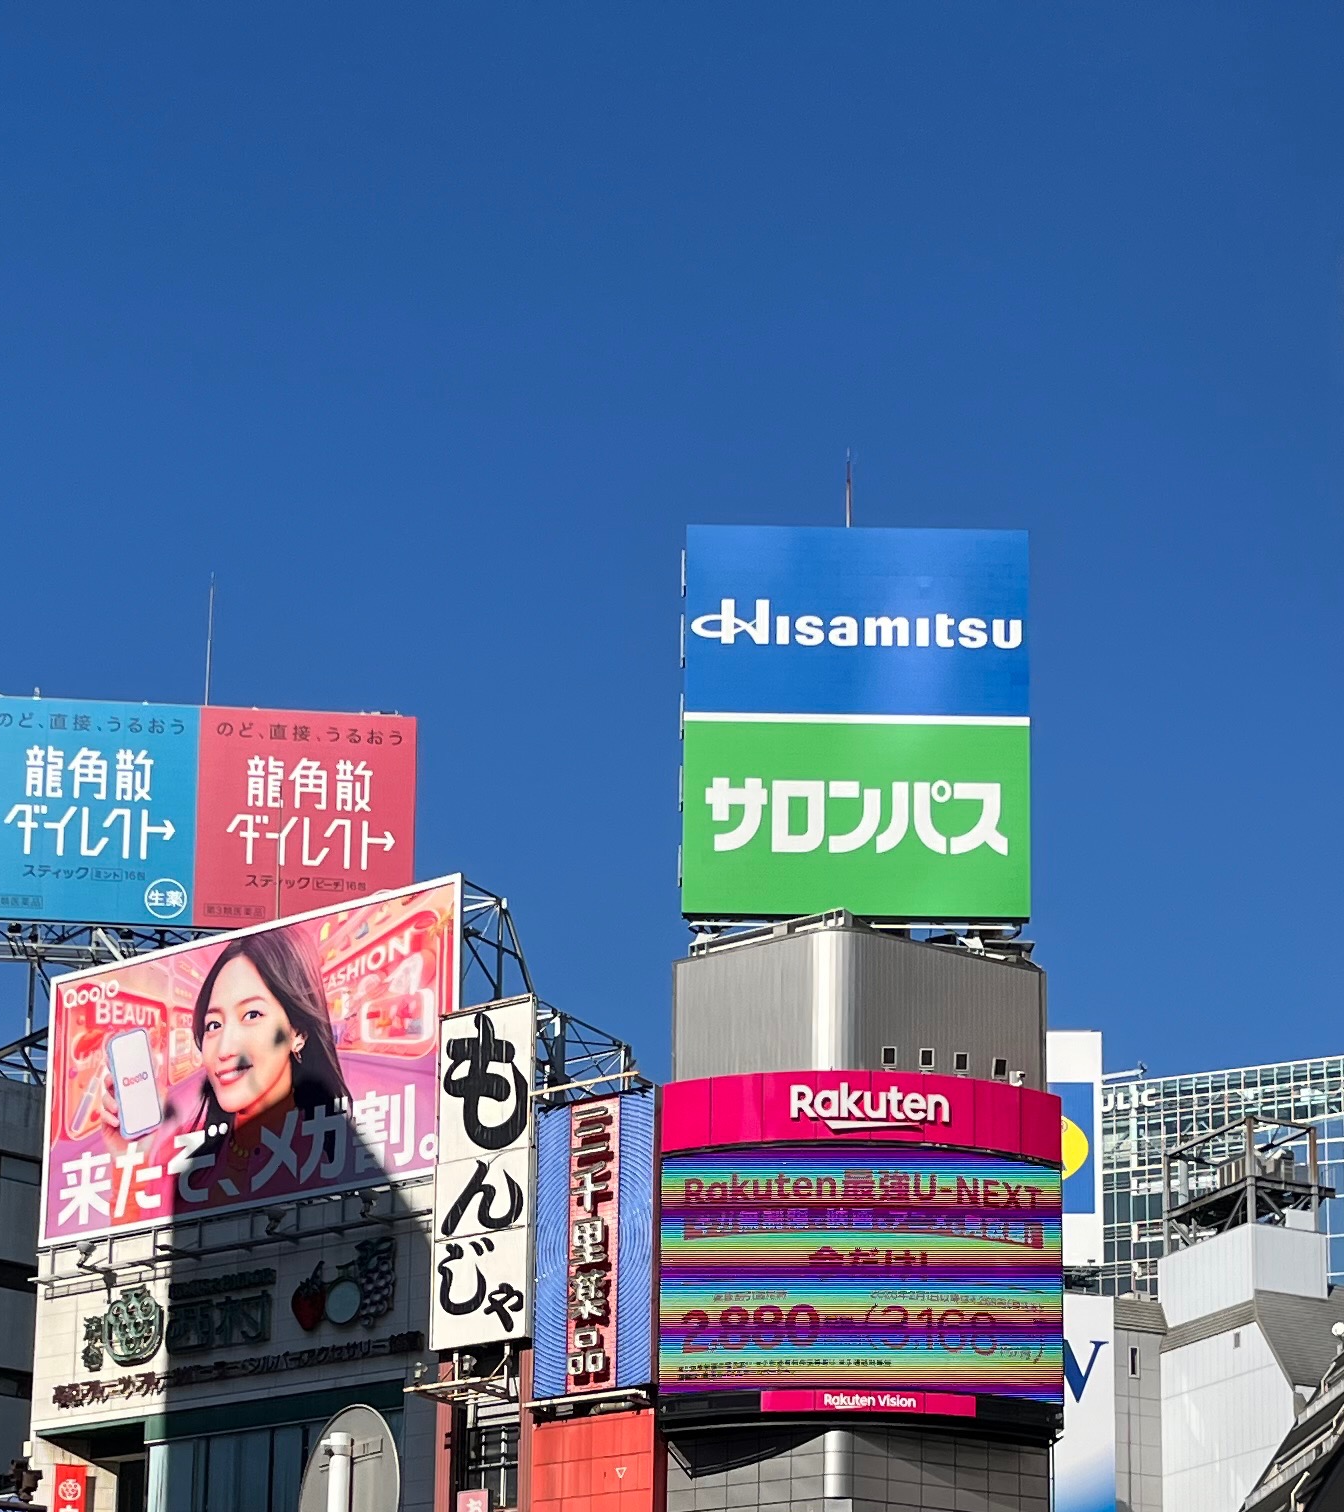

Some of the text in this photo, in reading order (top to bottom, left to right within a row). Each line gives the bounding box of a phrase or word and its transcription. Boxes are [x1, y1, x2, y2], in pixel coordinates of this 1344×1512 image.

[690, 598, 1023, 649] Hisamitsu
[216, 720, 403, 747] のど、直接、うるおう
[25, 744, 154, 802] 龍角散
[247, 754, 374, 813] 龍角散
[3, 803, 175, 861] ダイレクト
[226, 814, 396, 871] ダイレクト
[705, 777, 1009, 856] サロンパス
[22, 864, 89, 880] スティック
[147, 889, 184, 907] 生薬
[63, 979, 119, 1010] Qoo10
[788, 1082, 951, 1124] Rakuten
[438, 1011, 528, 1332] もんじゃ
[568, 1103, 611, 1377] 三千里薬品
[823, 1392, 916, 1409] Rakuten Vision
